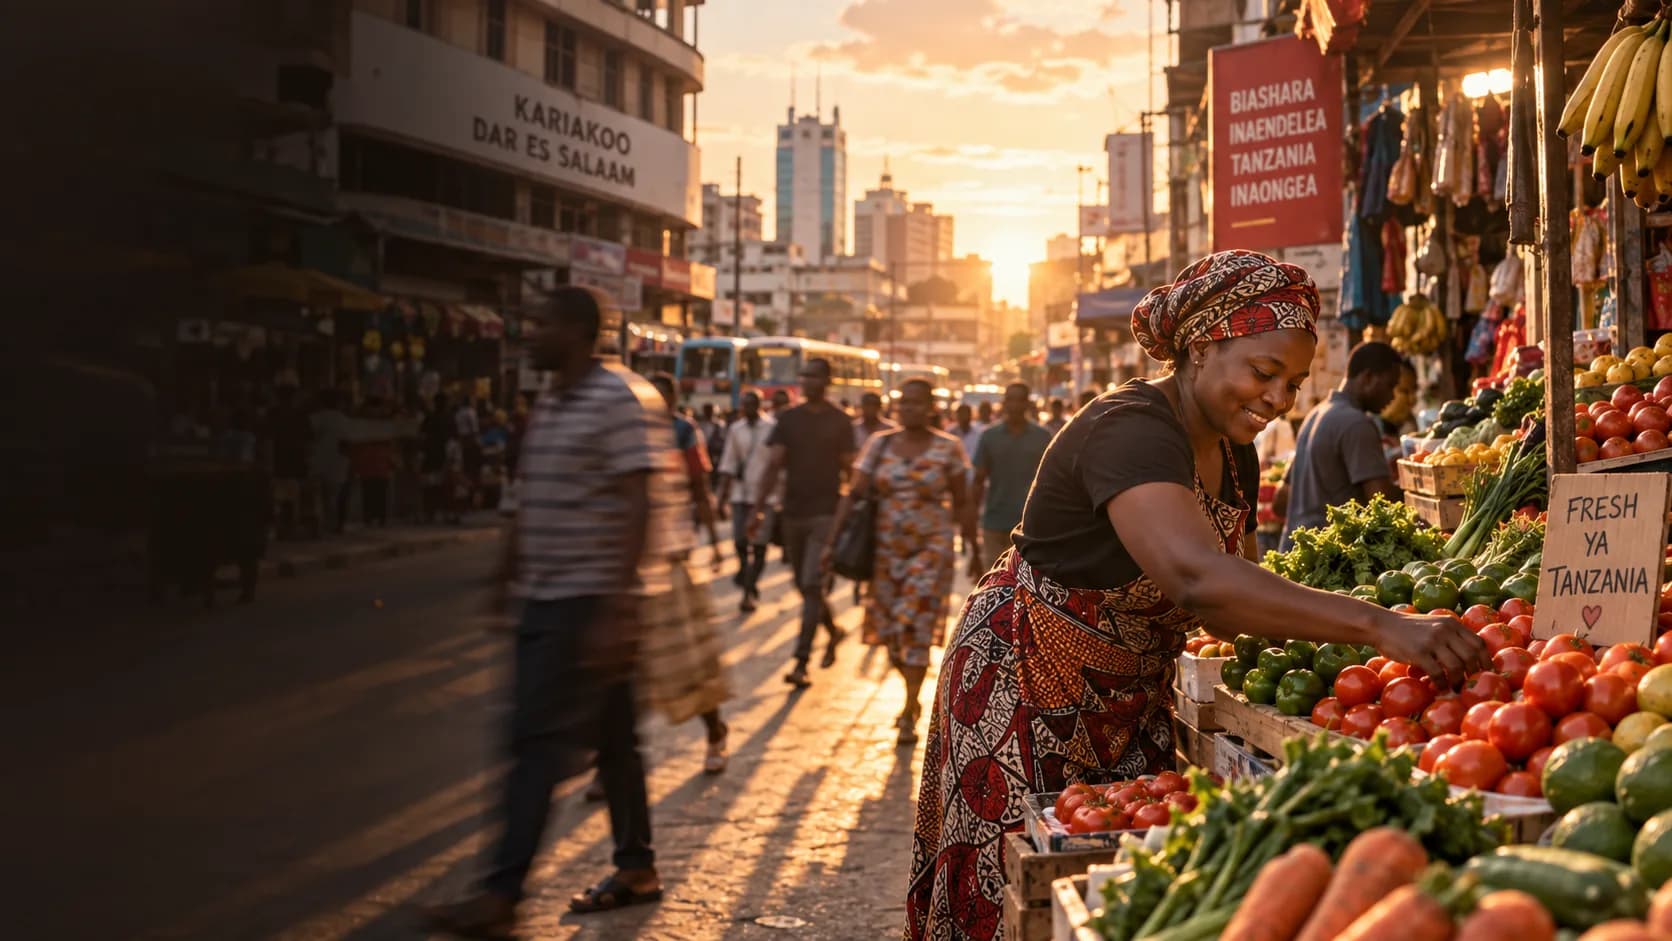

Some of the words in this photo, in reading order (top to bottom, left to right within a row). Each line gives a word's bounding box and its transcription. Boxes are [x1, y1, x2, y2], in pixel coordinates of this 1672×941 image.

[1230, 78, 1315, 114] BIASHARA
[514, 95, 631, 155] KARIAKOO
[1229, 108, 1327, 145] INAENDELEA
[473, 117, 517, 152] DAR
[526, 135, 550, 162] ES
[558, 144, 636, 187] SALAAM
[1230, 142, 1316, 176] TANZANIA
[1230, 173, 1317, 207] INAONGEA
[1566, 493, 1638, 524] FRESH
[1584, 530, 1608, 557] YA
[1548, 566, 1648, 597] TANZANIA
